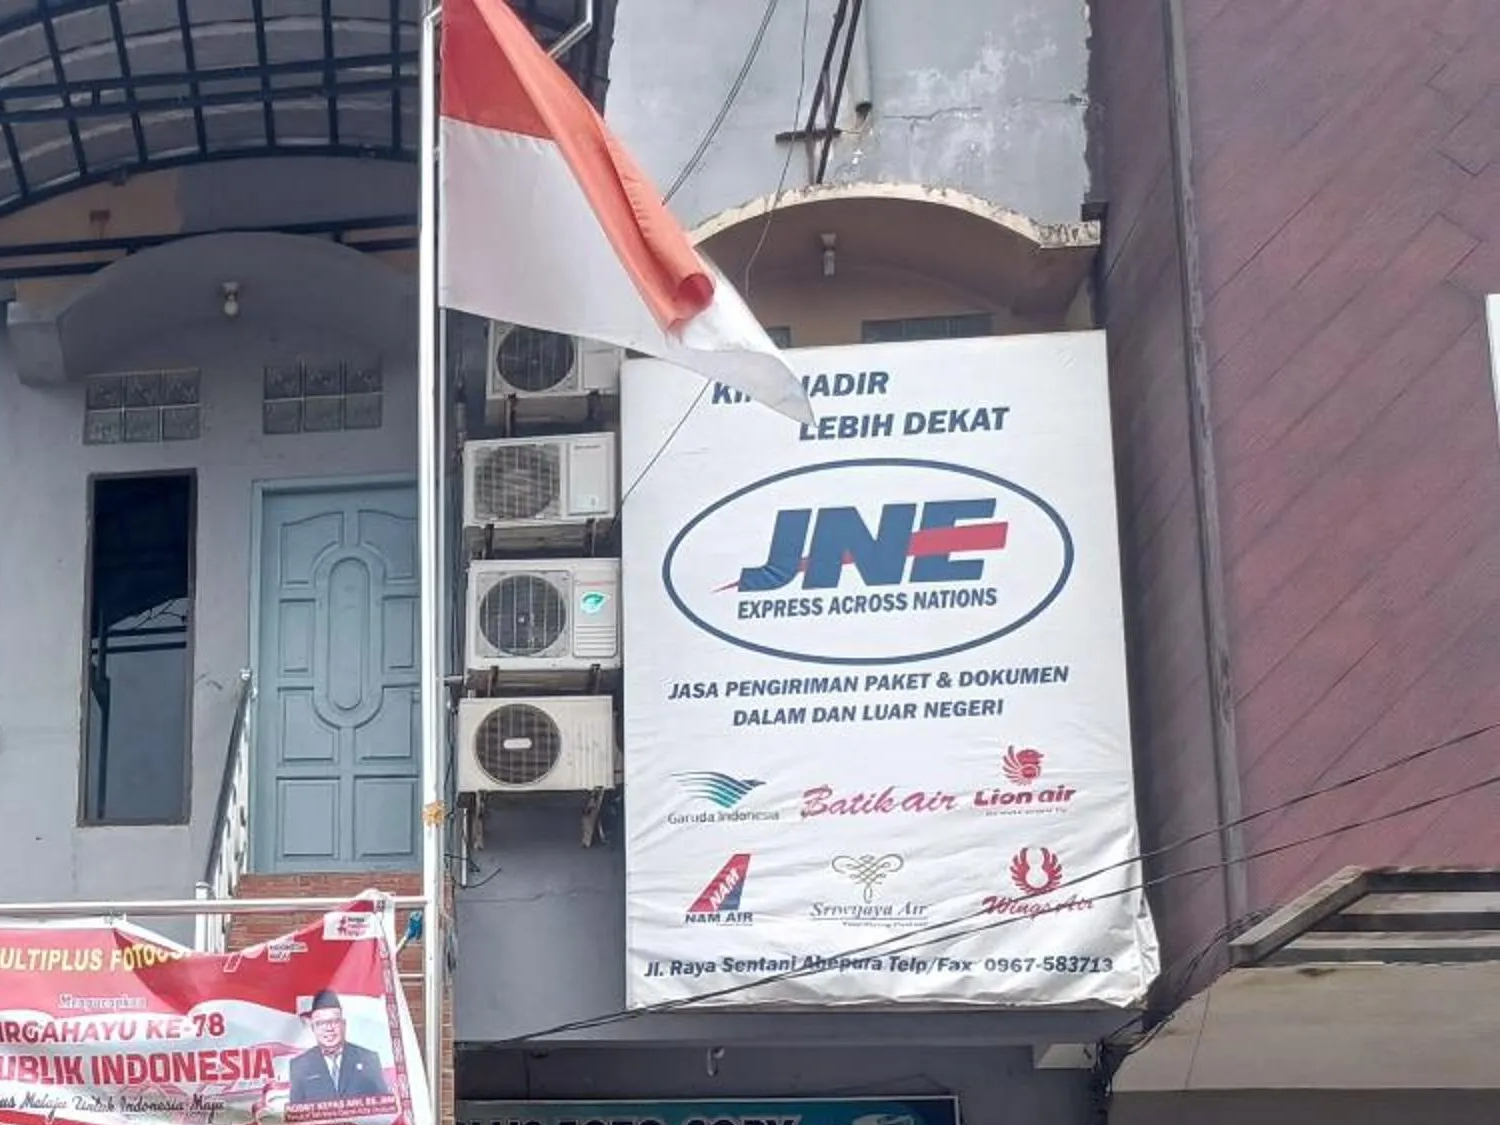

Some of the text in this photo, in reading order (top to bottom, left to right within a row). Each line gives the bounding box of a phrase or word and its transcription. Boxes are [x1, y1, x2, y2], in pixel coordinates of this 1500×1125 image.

[799, 407, 1010, 441] LEBIH DEKAT
[736, 497, 1009, 592] JNE
[737, 587, 998, 620] EXPRESS ACROSS NATIONS
[668, 666, 1069, 700] JASA PENGIRIMAN PAKET & DOKUMEN
[733, 698, 1004, 726] DALAM DAN LUAR NEGERI
[800, 785, 898, 819] Batik
[973, 785, 1077, 806] Lion air
[668, 808, 780, 824] Garuda Indonesia
[709, 867, 741, 910] NAM
[685, 911, 754, 923] NAM AIR
[644, 954, 1113, 977] Jl. Raya Sentani Abepura Telp/Fax 0967-583713
[145, 1012, 226, 1040] KE-78
[91, 1048, 276, 1086] INDONESIA
[120, 1096, 191, 1113] Indonesia
